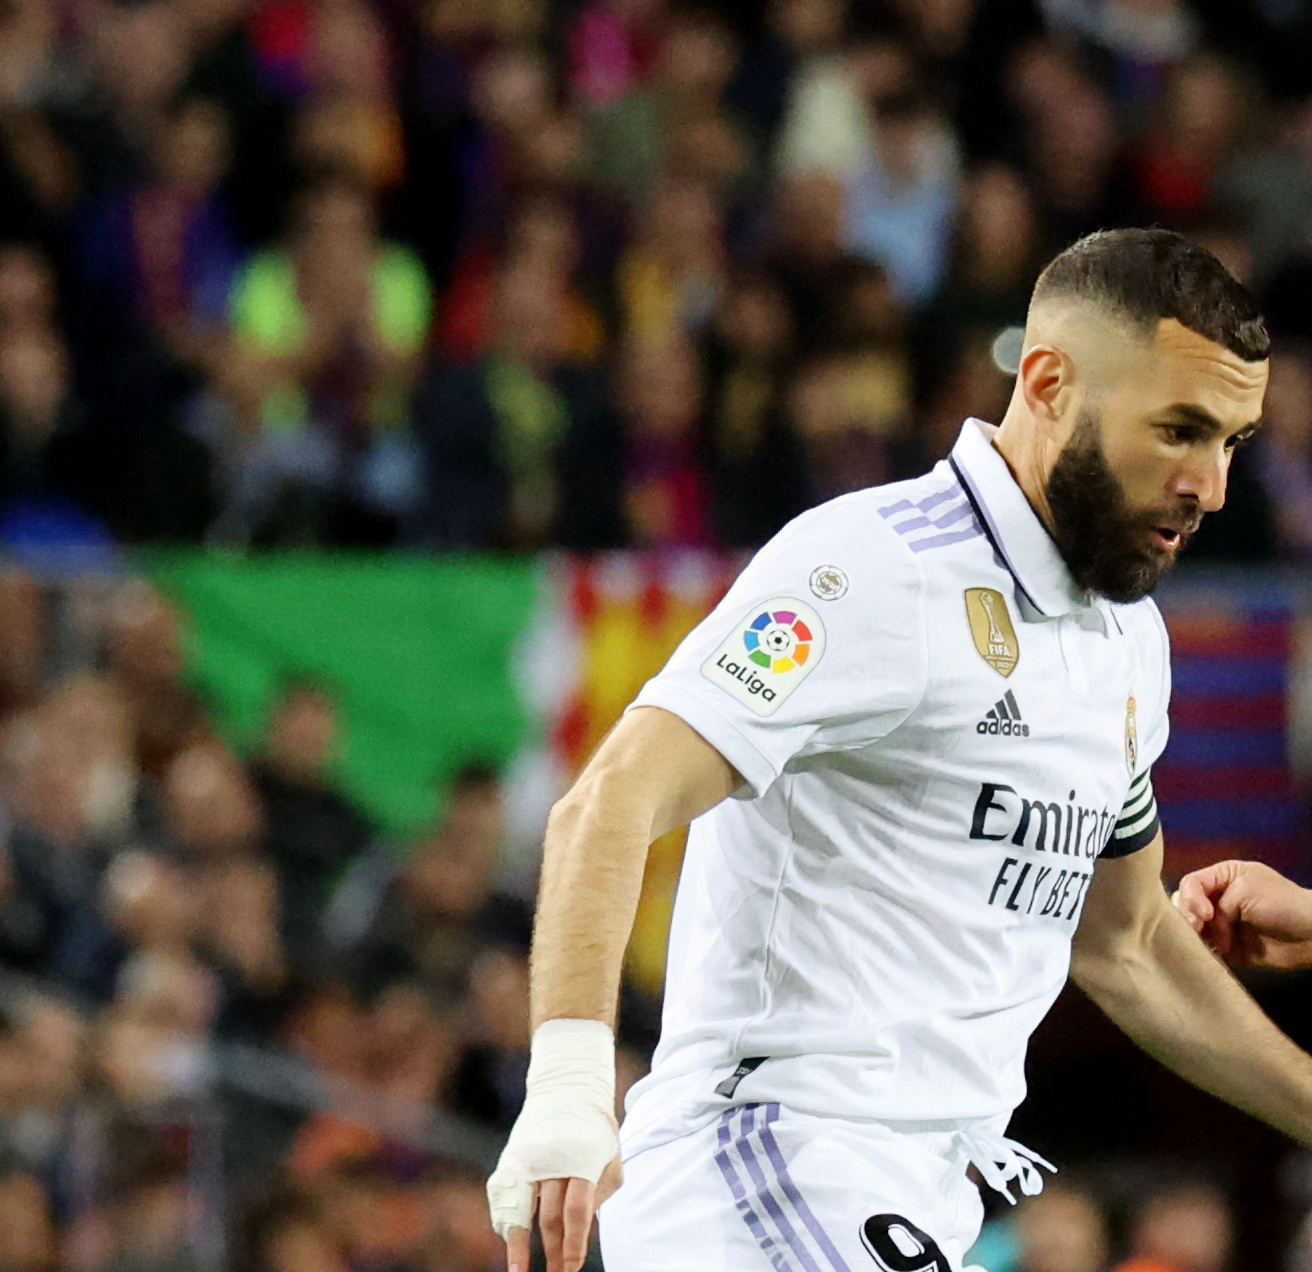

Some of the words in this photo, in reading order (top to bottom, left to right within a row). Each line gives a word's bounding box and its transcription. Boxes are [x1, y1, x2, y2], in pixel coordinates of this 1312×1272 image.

[989, 644, 1012, 657] FIFA
[716, 654, 777, 702] LaLiga
[976, 718, 1030, 737] adidas
[969, 782, 1117, 860] Emirate
[987, 857, 1051, 915] FLY
[1039, 869, 1094, 921] BET
